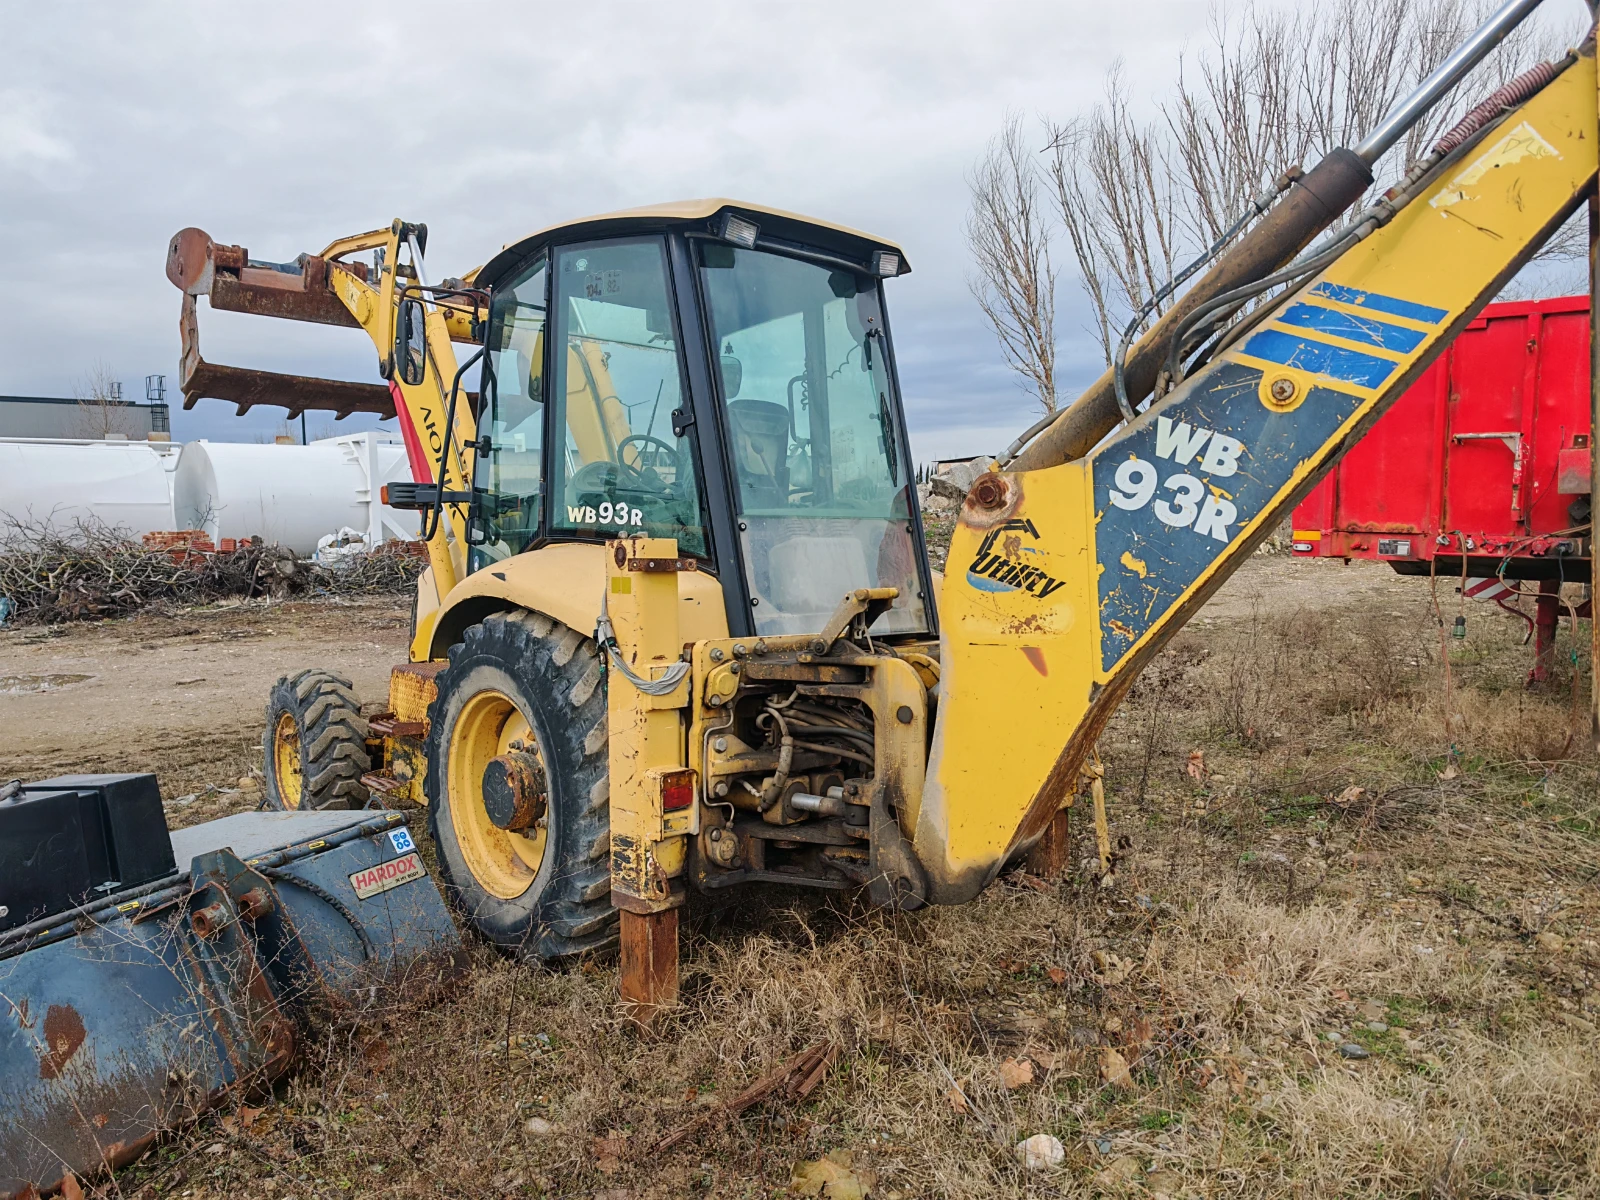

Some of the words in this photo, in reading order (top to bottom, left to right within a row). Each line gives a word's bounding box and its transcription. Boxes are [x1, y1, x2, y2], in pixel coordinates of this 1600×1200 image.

[1155, 415, 1243, 478] WB
[567, 502, 643, 526] WB93R
[1109, 458, 1238, 543] 93R
[969, 551, 1067, 599] Utility
[355, 855, 417, 890] HARDOX
